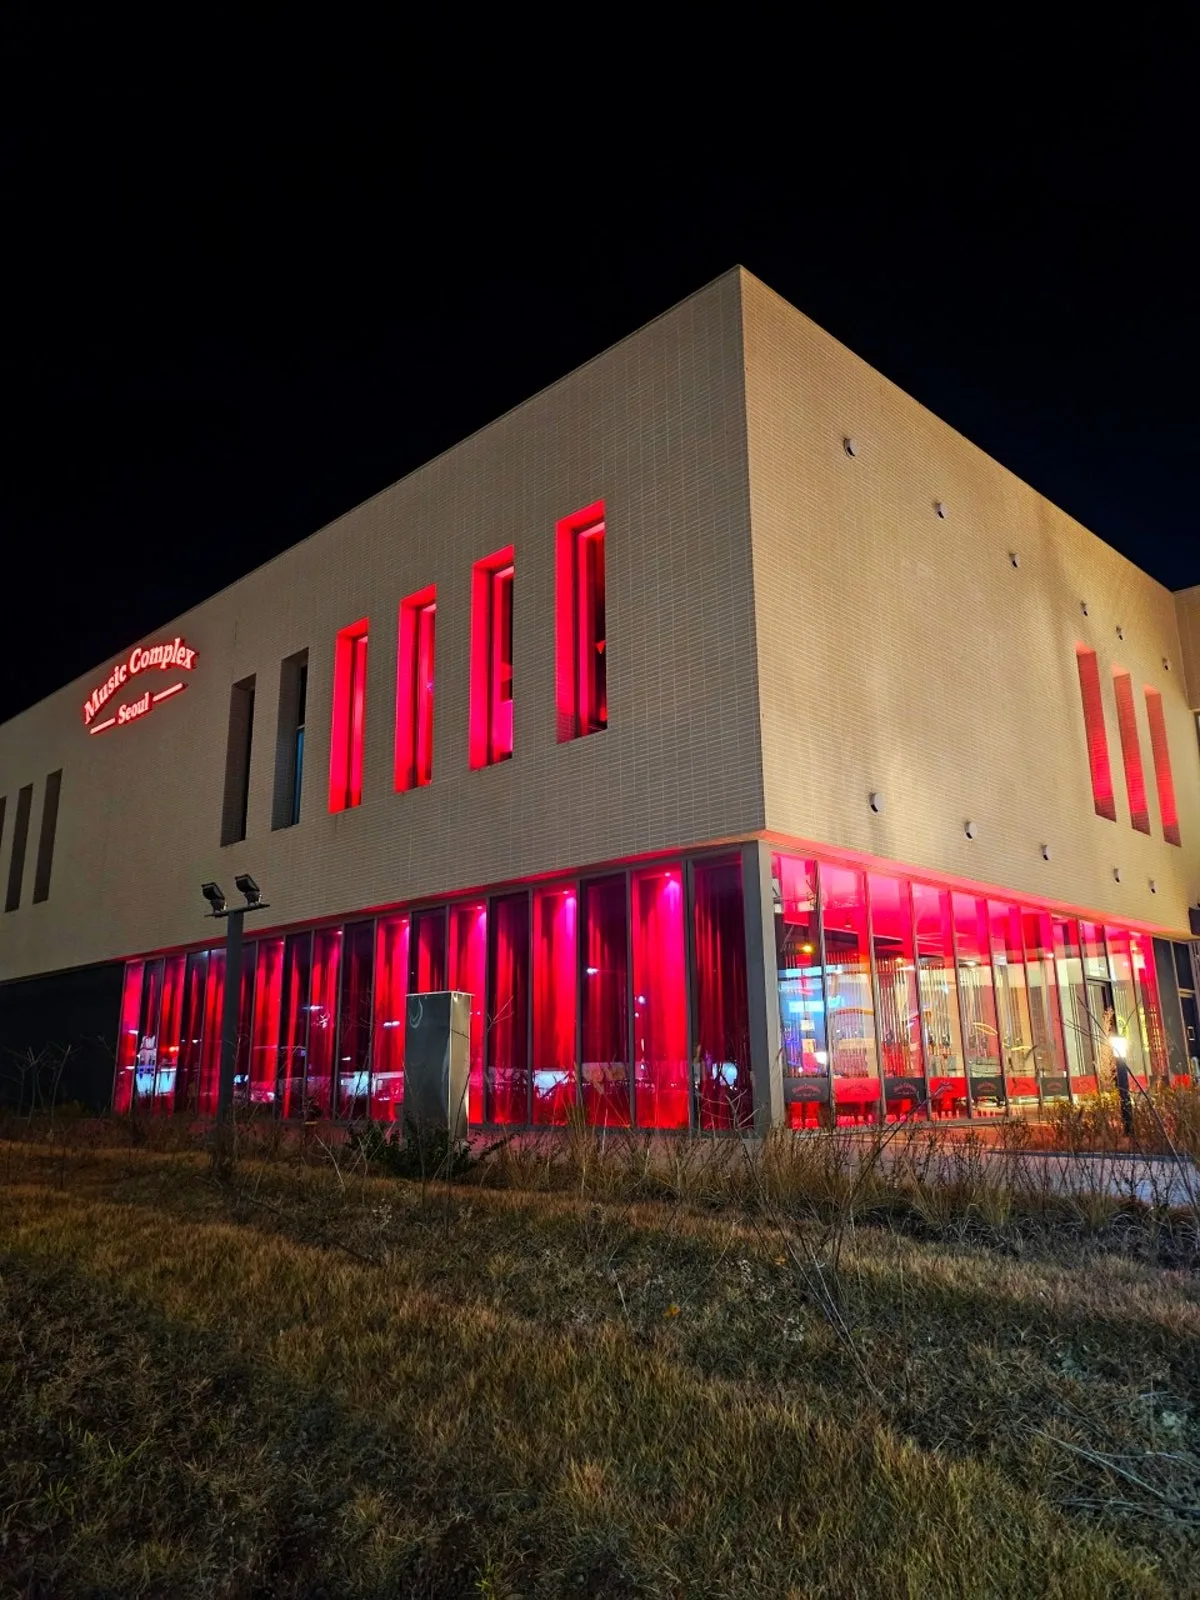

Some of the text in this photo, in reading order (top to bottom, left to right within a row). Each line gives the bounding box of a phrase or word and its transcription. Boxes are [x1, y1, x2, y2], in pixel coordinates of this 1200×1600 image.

[84, 637, 195, 724] Music Complex
[118, 691, 150, 724] Seoul
